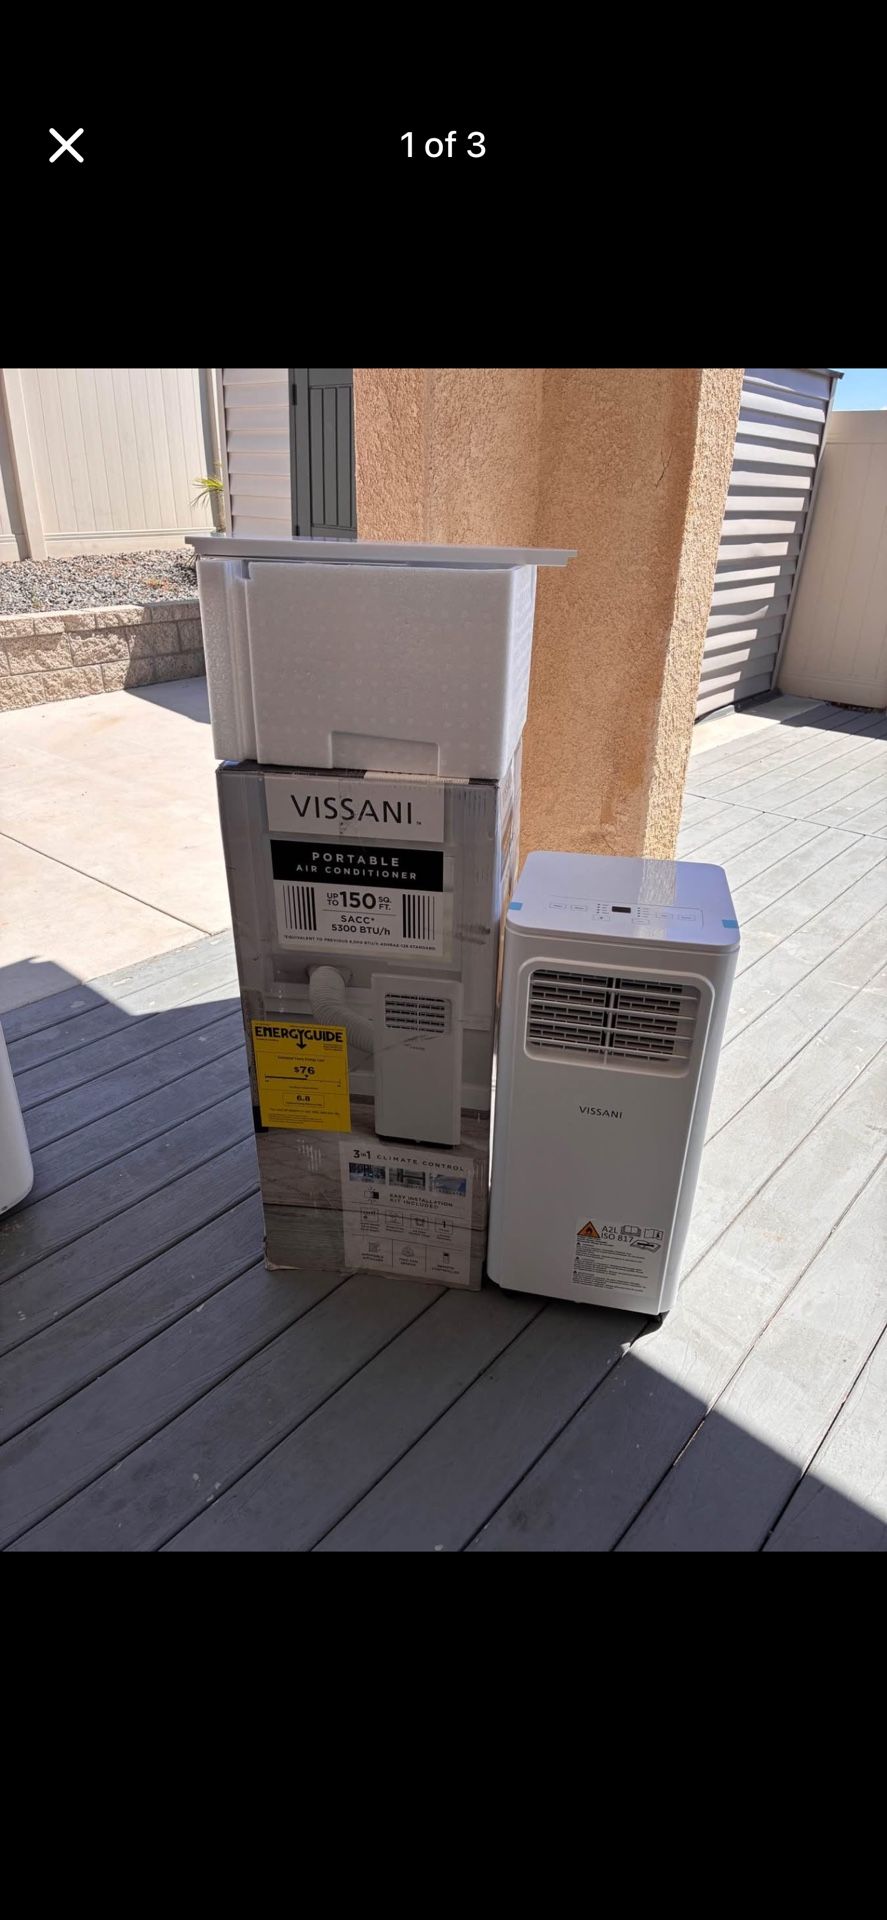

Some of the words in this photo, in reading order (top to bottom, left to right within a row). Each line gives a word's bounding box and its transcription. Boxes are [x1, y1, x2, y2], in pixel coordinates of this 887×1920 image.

[312, 852, 400, 867] PORTABLE
[296, 864, 318, 873] AIR
[325, 866, 417, 880] CONDITIONER
[326, 892, 339, 900] UP
[339, 891, 377, 910] 150
[378, 896, 392, 904] SQ.
[327, 899, 340, 907] TO
[378, 903, 392, 911] FT.
[331, 923, 358, 933] 5300
[359, 925, 391, 936] BTU/h
[294, 1065, 315, 1075] $76
[578, 1105, 623, 1119] VISSANI
[376, 1154, 419, 1165] CLIMATE
[422, 1160, 464, 1172] CONTROL
[402, 1200, 439, 1210] INCLUDED
[407, 1196, 454, 1208] INSTALLATION
[601, 1225, 618, 1234] A2L
[600, 1232, 616, 1241] ISO
[617, 1234, 634, 1243] 817
